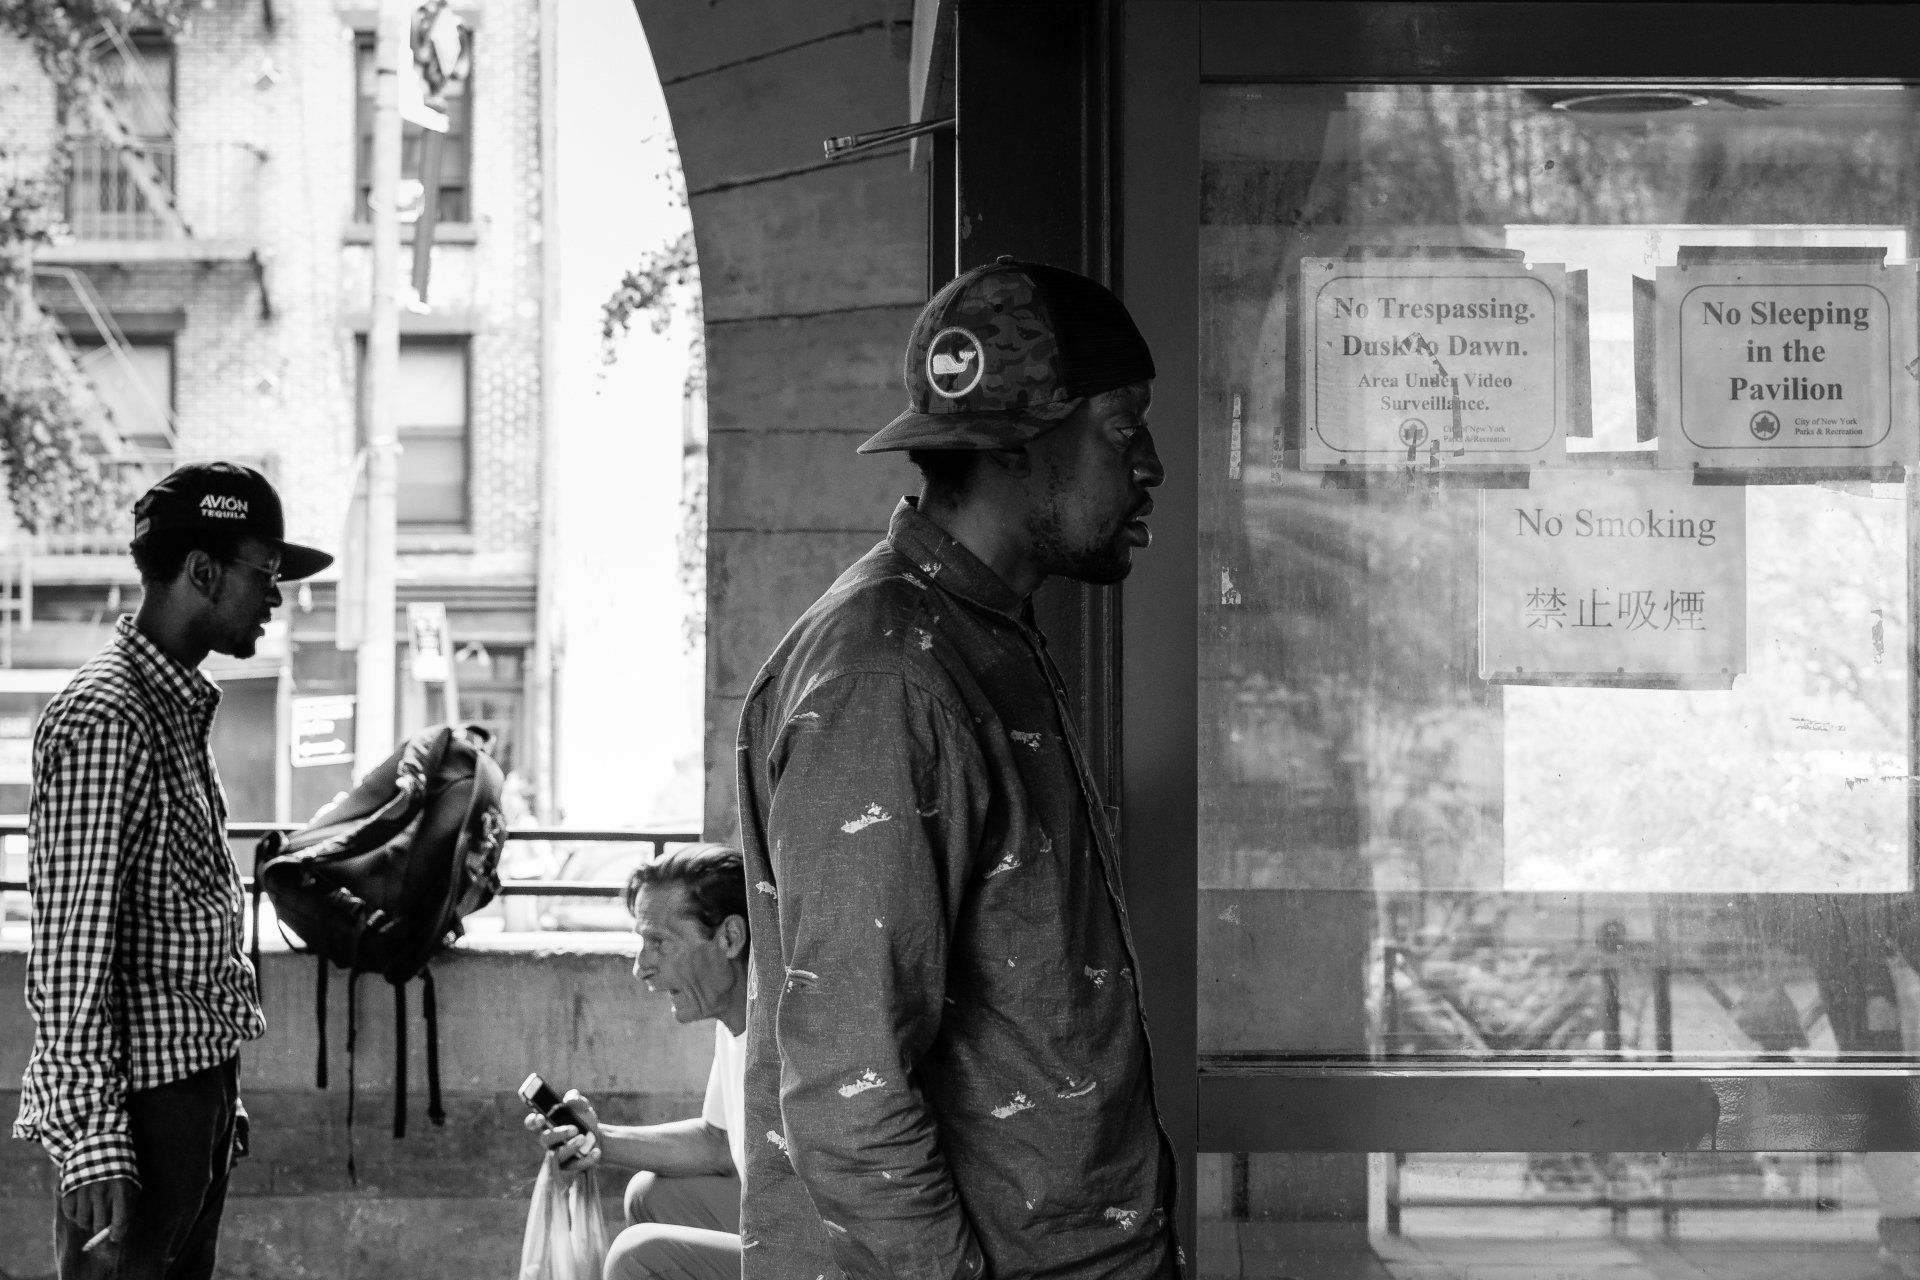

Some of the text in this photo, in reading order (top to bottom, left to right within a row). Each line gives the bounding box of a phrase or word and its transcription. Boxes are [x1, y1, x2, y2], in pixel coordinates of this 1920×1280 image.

[1333, 297, 1536, 325] No Trespassing.
[1702, 301, 1870, 331] No Sleeping
[1342, 335, 1409, 356] Dusk
[1447, 335, 1529, 356] Dawn.
[1746, 339, 1826, 363] in the
[1358, 373, 1513, 388] Area Under Video
[1728, 377, 1844, 401] Pavilion
[1380, 395, 1490, 411] Surveillance.
[1488, 425, 1506, 433] York
[1794, 417, 1858, 427] City of New York
[1794, 428, 1863, 436] Parks & Recreation
[200, 508, 247, 520] TEQUILA
[1515, 508, 1716, 547] No Smoking
[1525, 586, 1707, 632] 禁止吸煙
